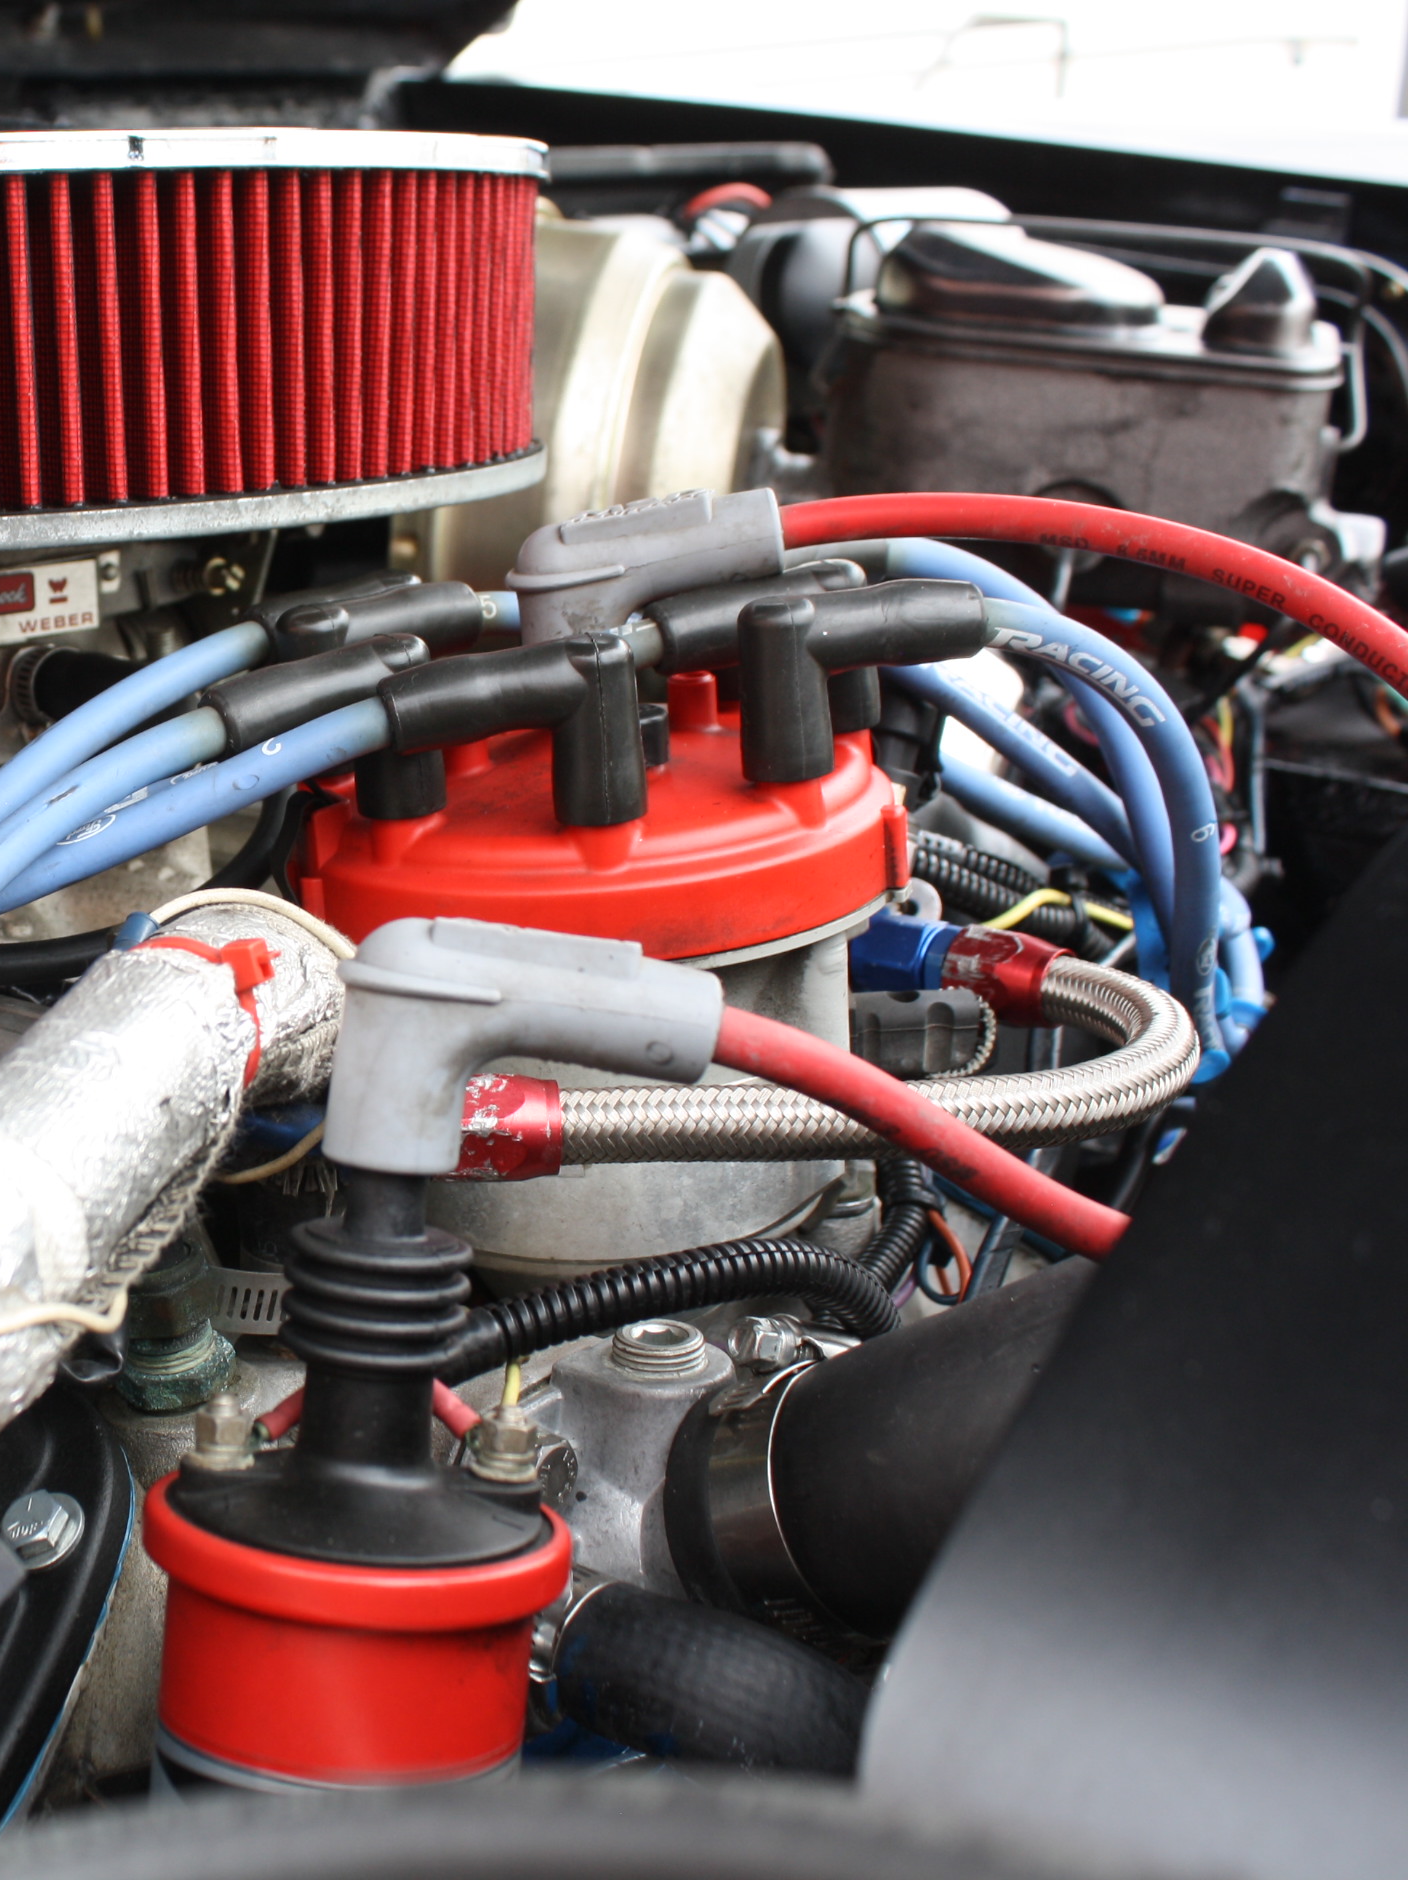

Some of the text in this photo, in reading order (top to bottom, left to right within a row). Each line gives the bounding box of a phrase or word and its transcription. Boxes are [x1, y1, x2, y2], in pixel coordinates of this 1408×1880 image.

[1039, 532, 1090, 551] MSD
[1210, 568, 1288, 610] SUPER
[18, 611, 94, 634] WEBER
[480, 594, 497, 619] 5
[993, 626, 1167, 728] RACING
